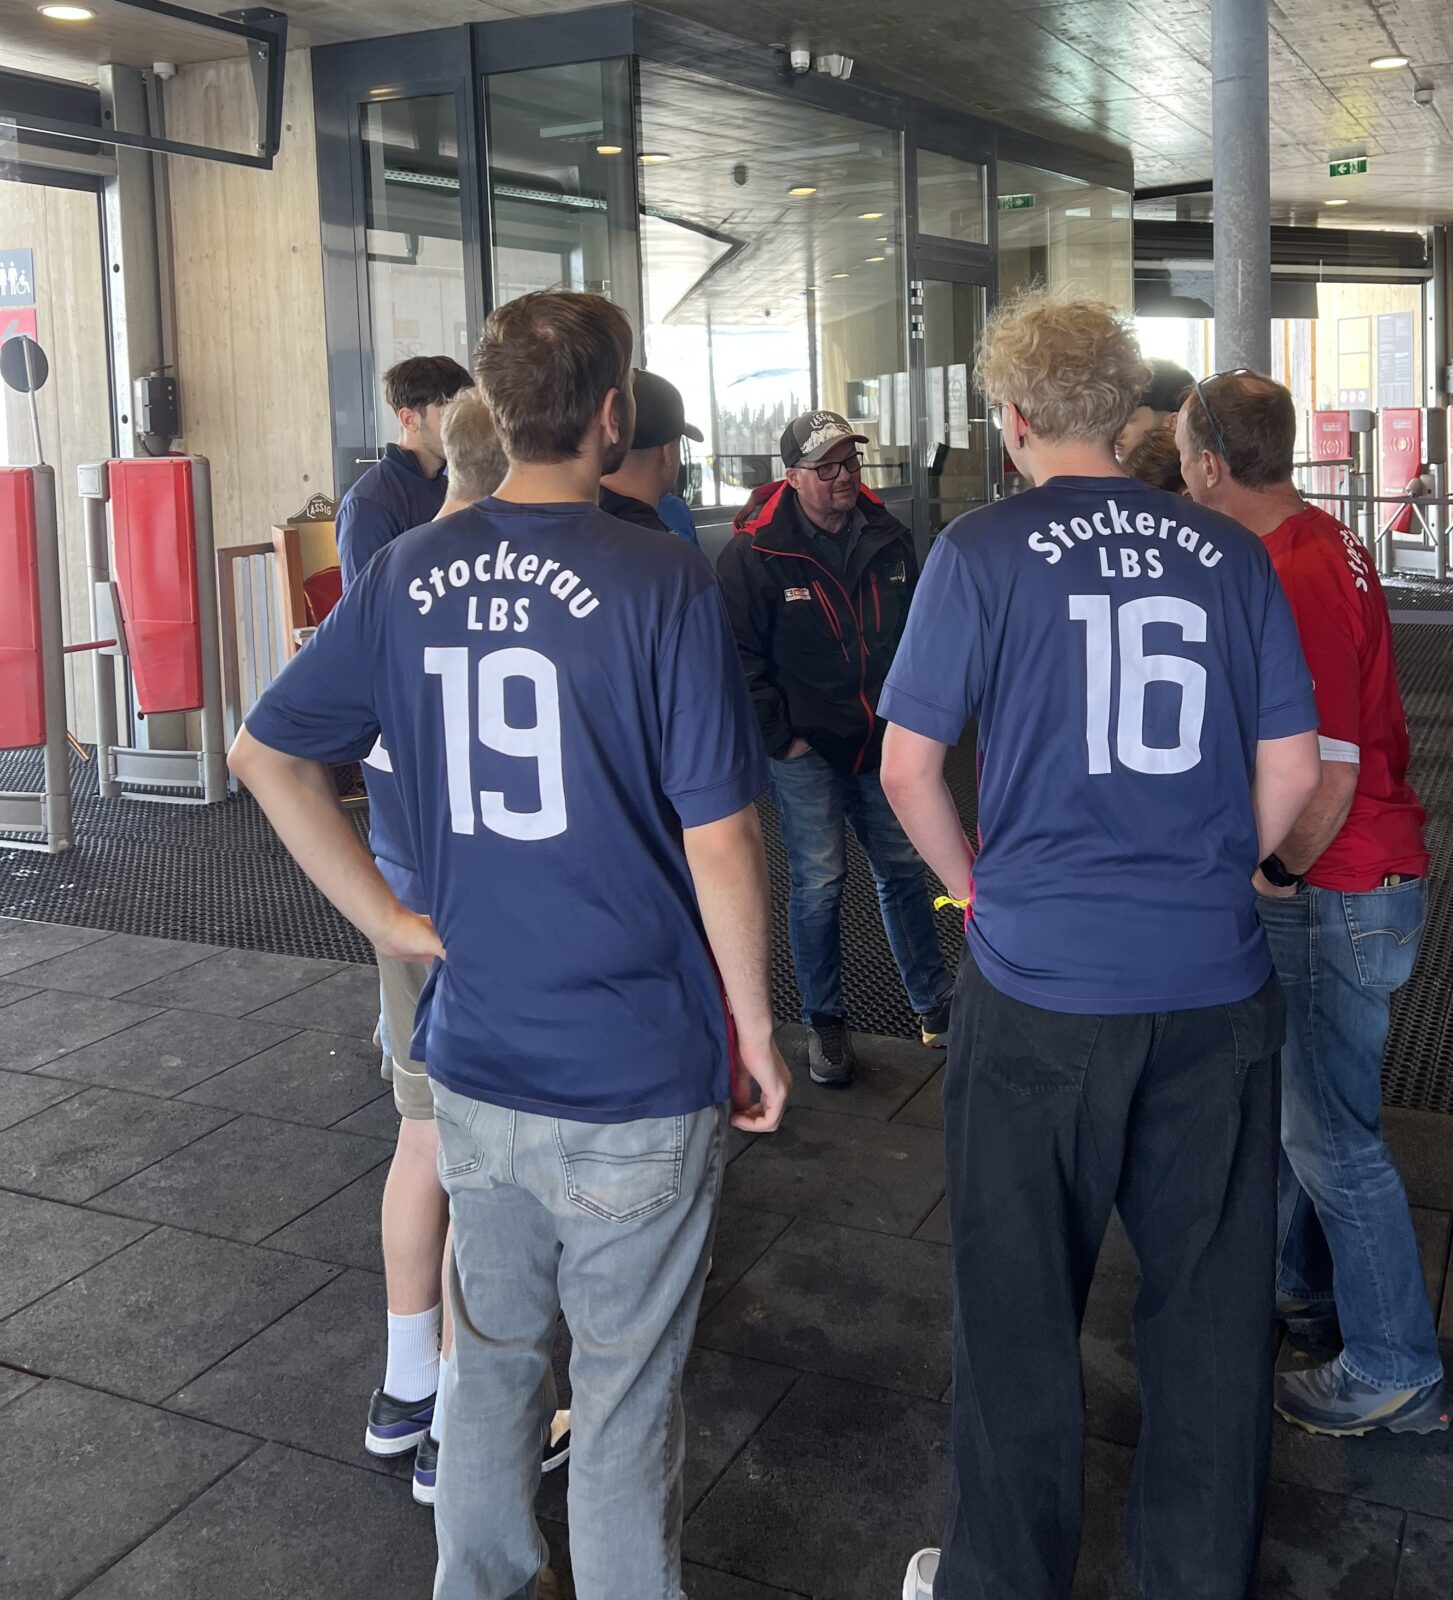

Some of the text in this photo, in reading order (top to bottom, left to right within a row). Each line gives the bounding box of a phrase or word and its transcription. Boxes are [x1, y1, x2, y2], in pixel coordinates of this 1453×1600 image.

[306, 503, 332, 519] LASSIG
[1027, 500, 1223, 569] Stockerau
[408, 541, 600, 619] Stockerau
[1099, 547, 1164, 579] LBS
[467, 596, 530, 633] LBS
[1069, 595, 1207, 775] 16
[424, 646, 568, 841] 19
